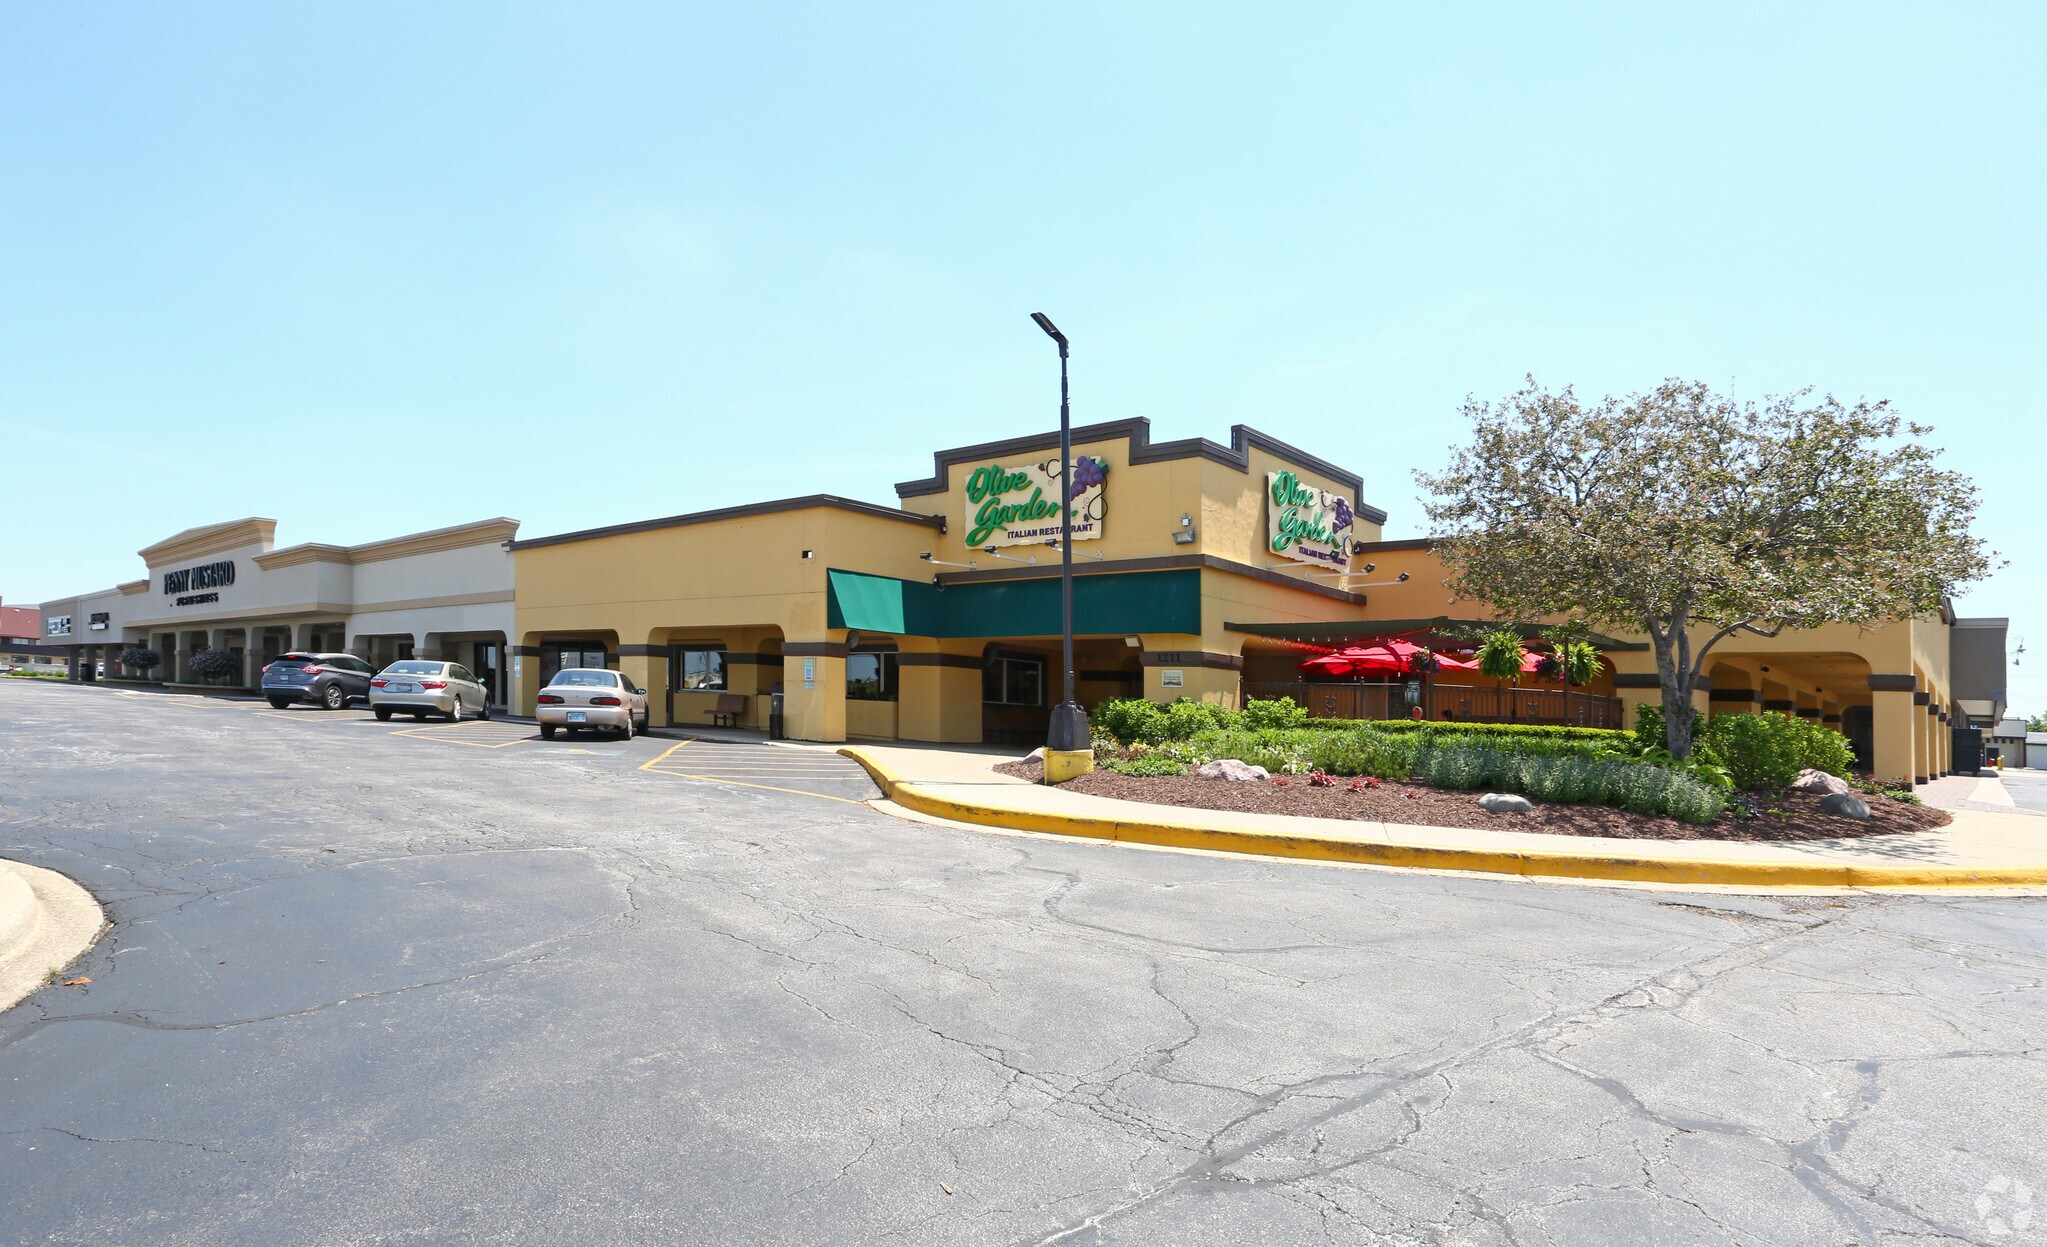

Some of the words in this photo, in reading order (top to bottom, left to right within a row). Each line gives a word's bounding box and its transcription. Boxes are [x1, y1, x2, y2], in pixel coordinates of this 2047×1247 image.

[966, 464, 1034, 504] Olive
[1271, 470, 1318, 509] Olive
[1007, 527, 1038, 540] ITALIAN
[1040, 523, 1094, 536] RESTARANT
[1272, 507, 1342, 552] Garden
[1157, 653, 1180, 663] 1211
